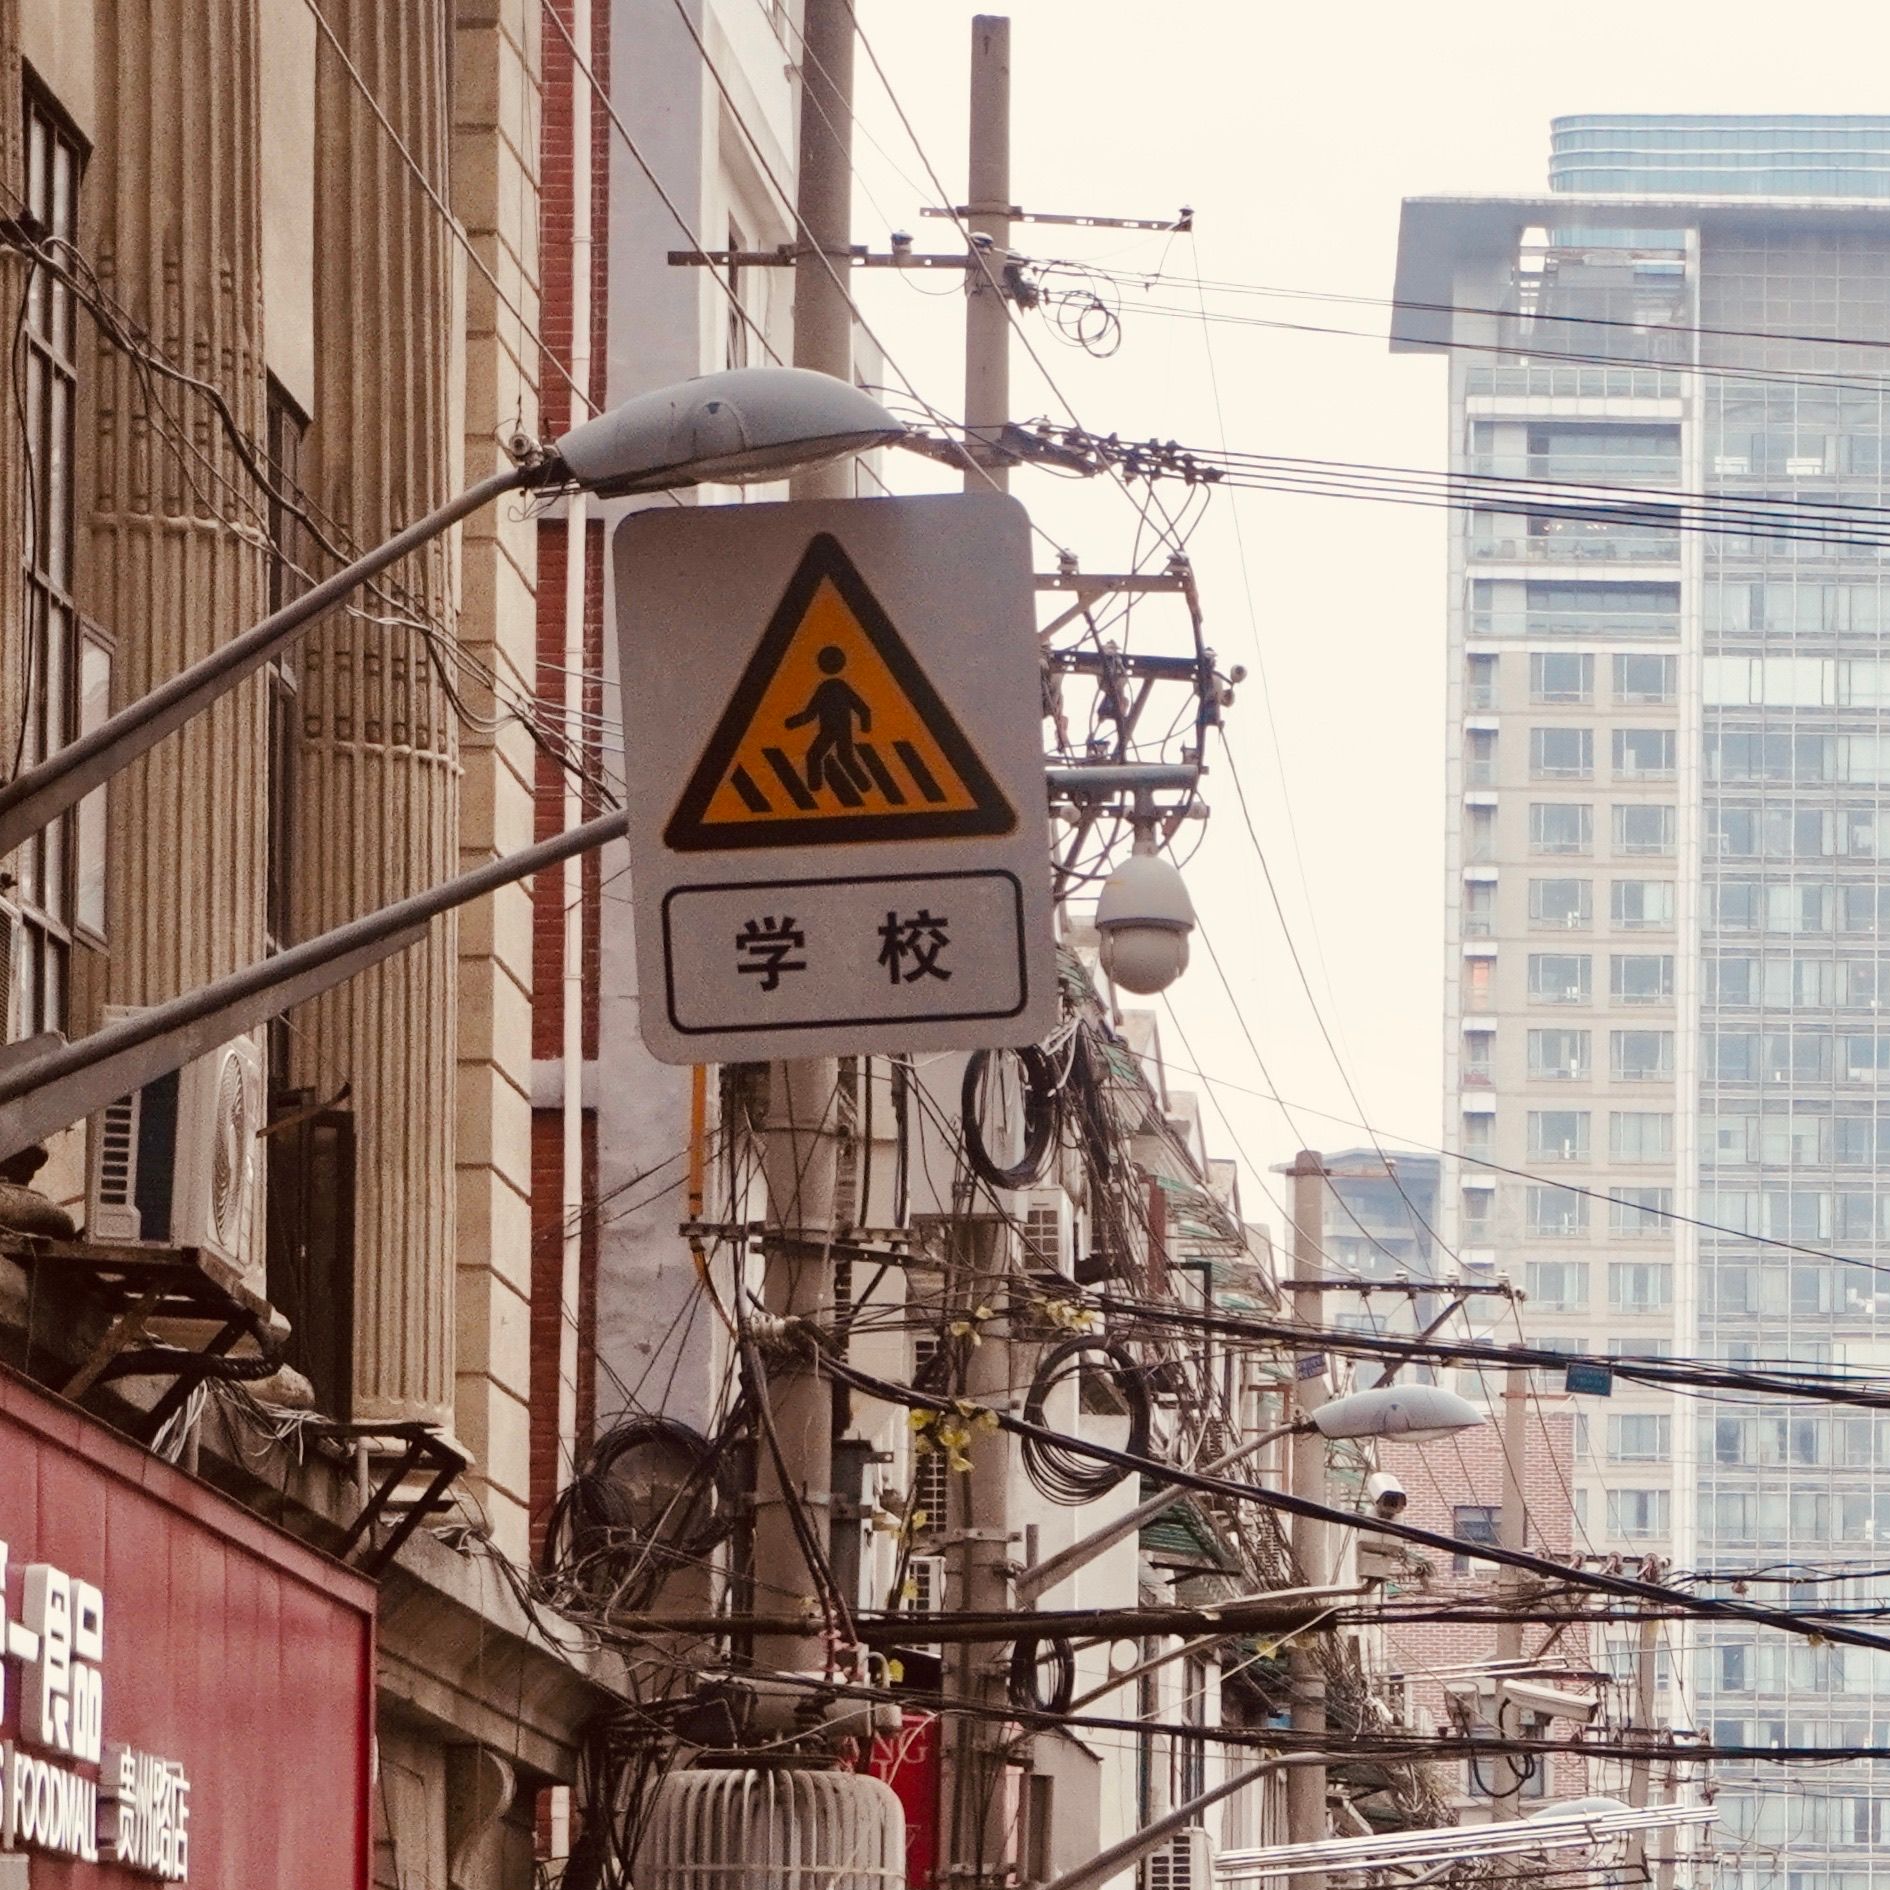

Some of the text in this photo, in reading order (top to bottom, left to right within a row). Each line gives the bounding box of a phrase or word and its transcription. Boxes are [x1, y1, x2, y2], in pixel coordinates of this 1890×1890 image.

[736, 909, 953, 991] 学校
[0, 1541, 103, 1764] 一食品
[13, 1751, 99, 1863] FOODMALL
[118, 1744, 191, 1882] 贵州路店
